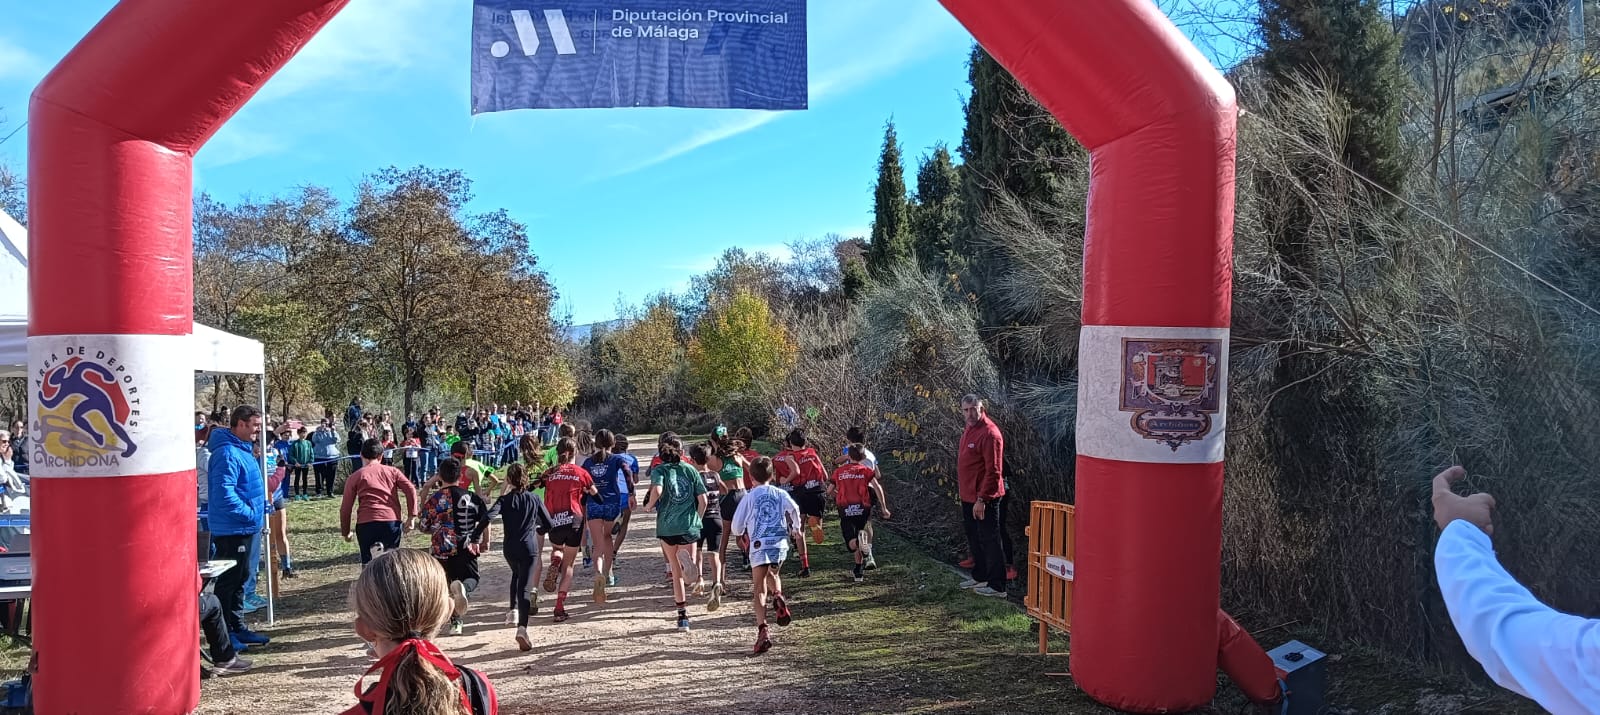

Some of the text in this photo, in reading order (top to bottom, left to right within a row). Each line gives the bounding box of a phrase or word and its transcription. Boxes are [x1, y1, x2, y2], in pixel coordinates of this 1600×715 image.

[612, 9, 702, 24] Diputación
[707, 10, 788, 24] Provincial
[612, 25, 633, 38] de
[637, 25, 699, 41] Málaga
[35, 346, 140, 428] AREA DE DEPORTES
